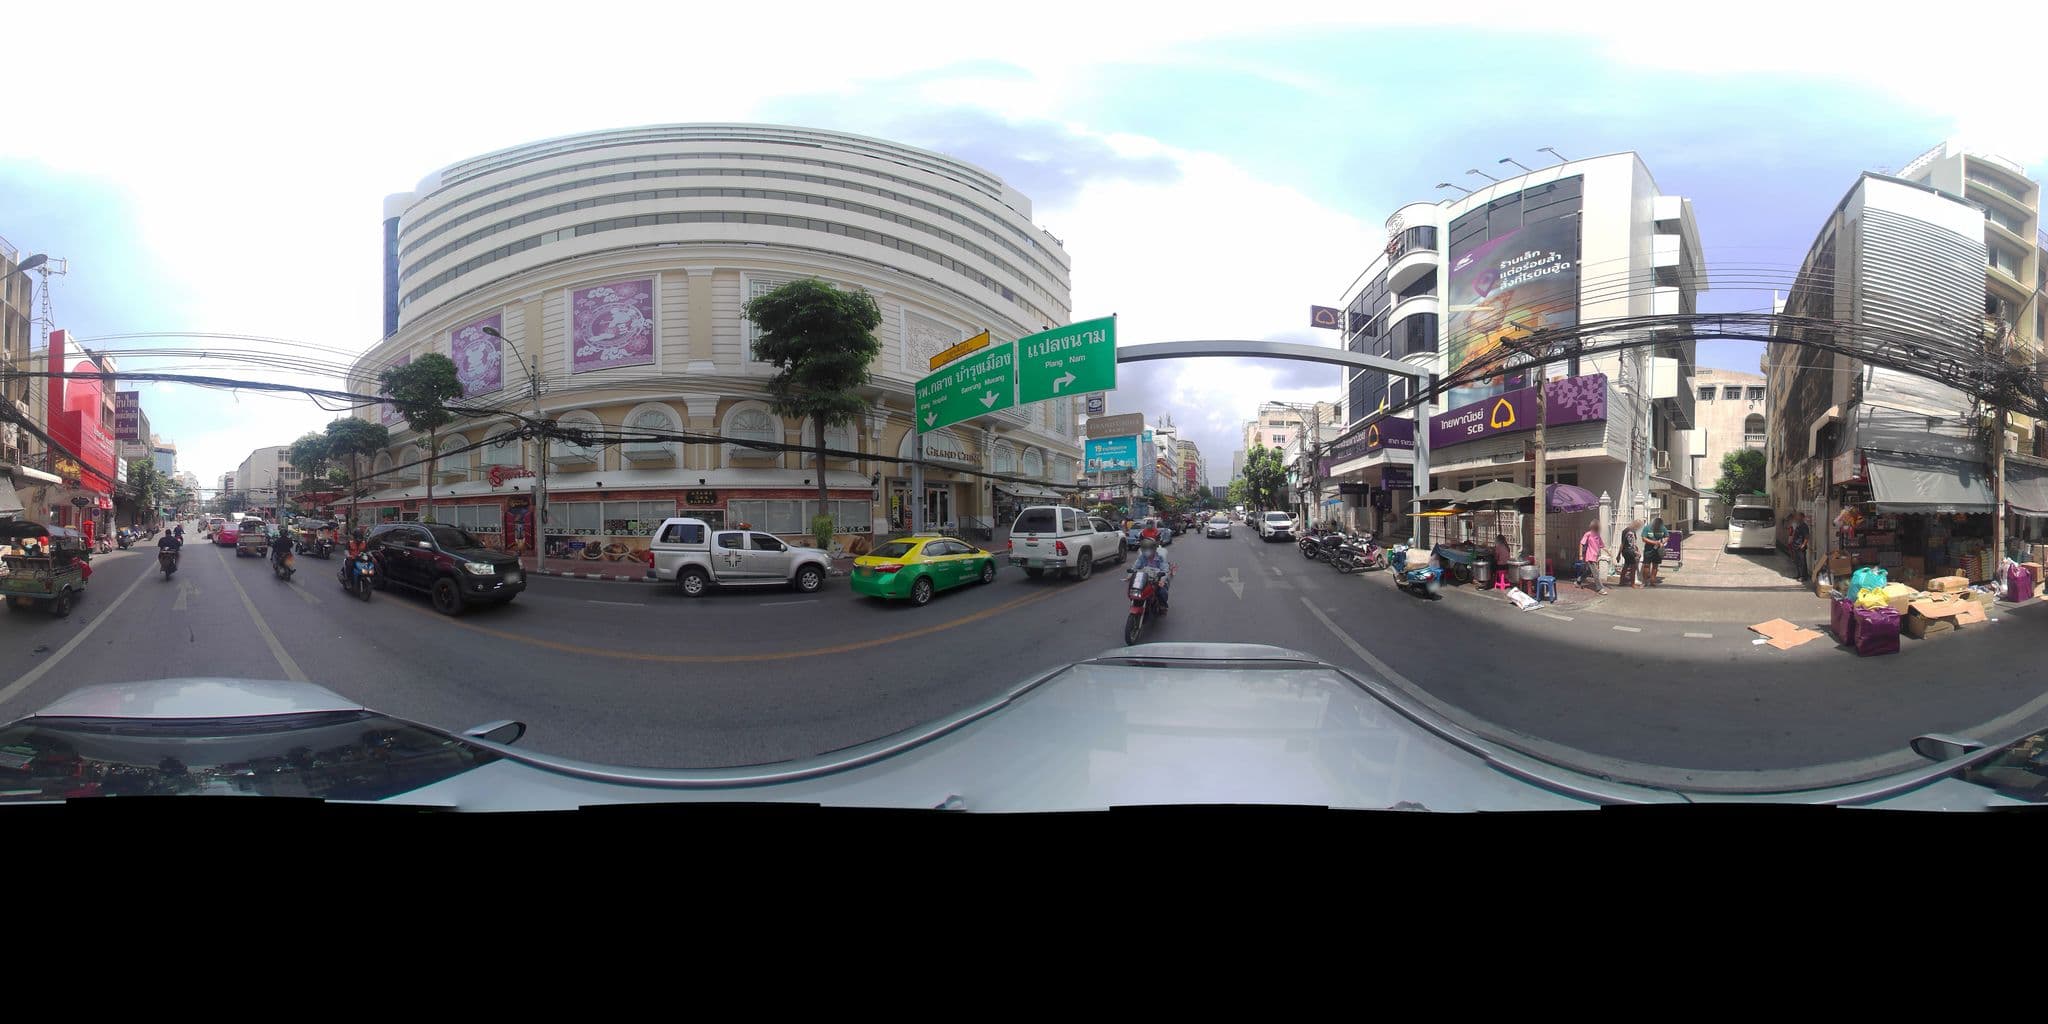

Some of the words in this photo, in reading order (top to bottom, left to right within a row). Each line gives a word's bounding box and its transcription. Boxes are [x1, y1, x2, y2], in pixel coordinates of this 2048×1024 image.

[1500, 250, 1541, 269] ร้านเล็ก
[1500, 251, 1562, 278] แต่อร่อยล้ำ
[1028, 329, 1106, 358] แปลงนาม
[1045, 360, 1063, 368] Plang
[1069, 355, 1086, 363] Nam
[916, 375, 953, 399] รพ.กลาง
[956, 352, 1011, 382] บำรุงเมือง
[1441, 408, 1484, 430] ไทยพาณิชย์
[1467, 423, 1484, 435] SCB
[925, 445, 956, 459] GRAND
